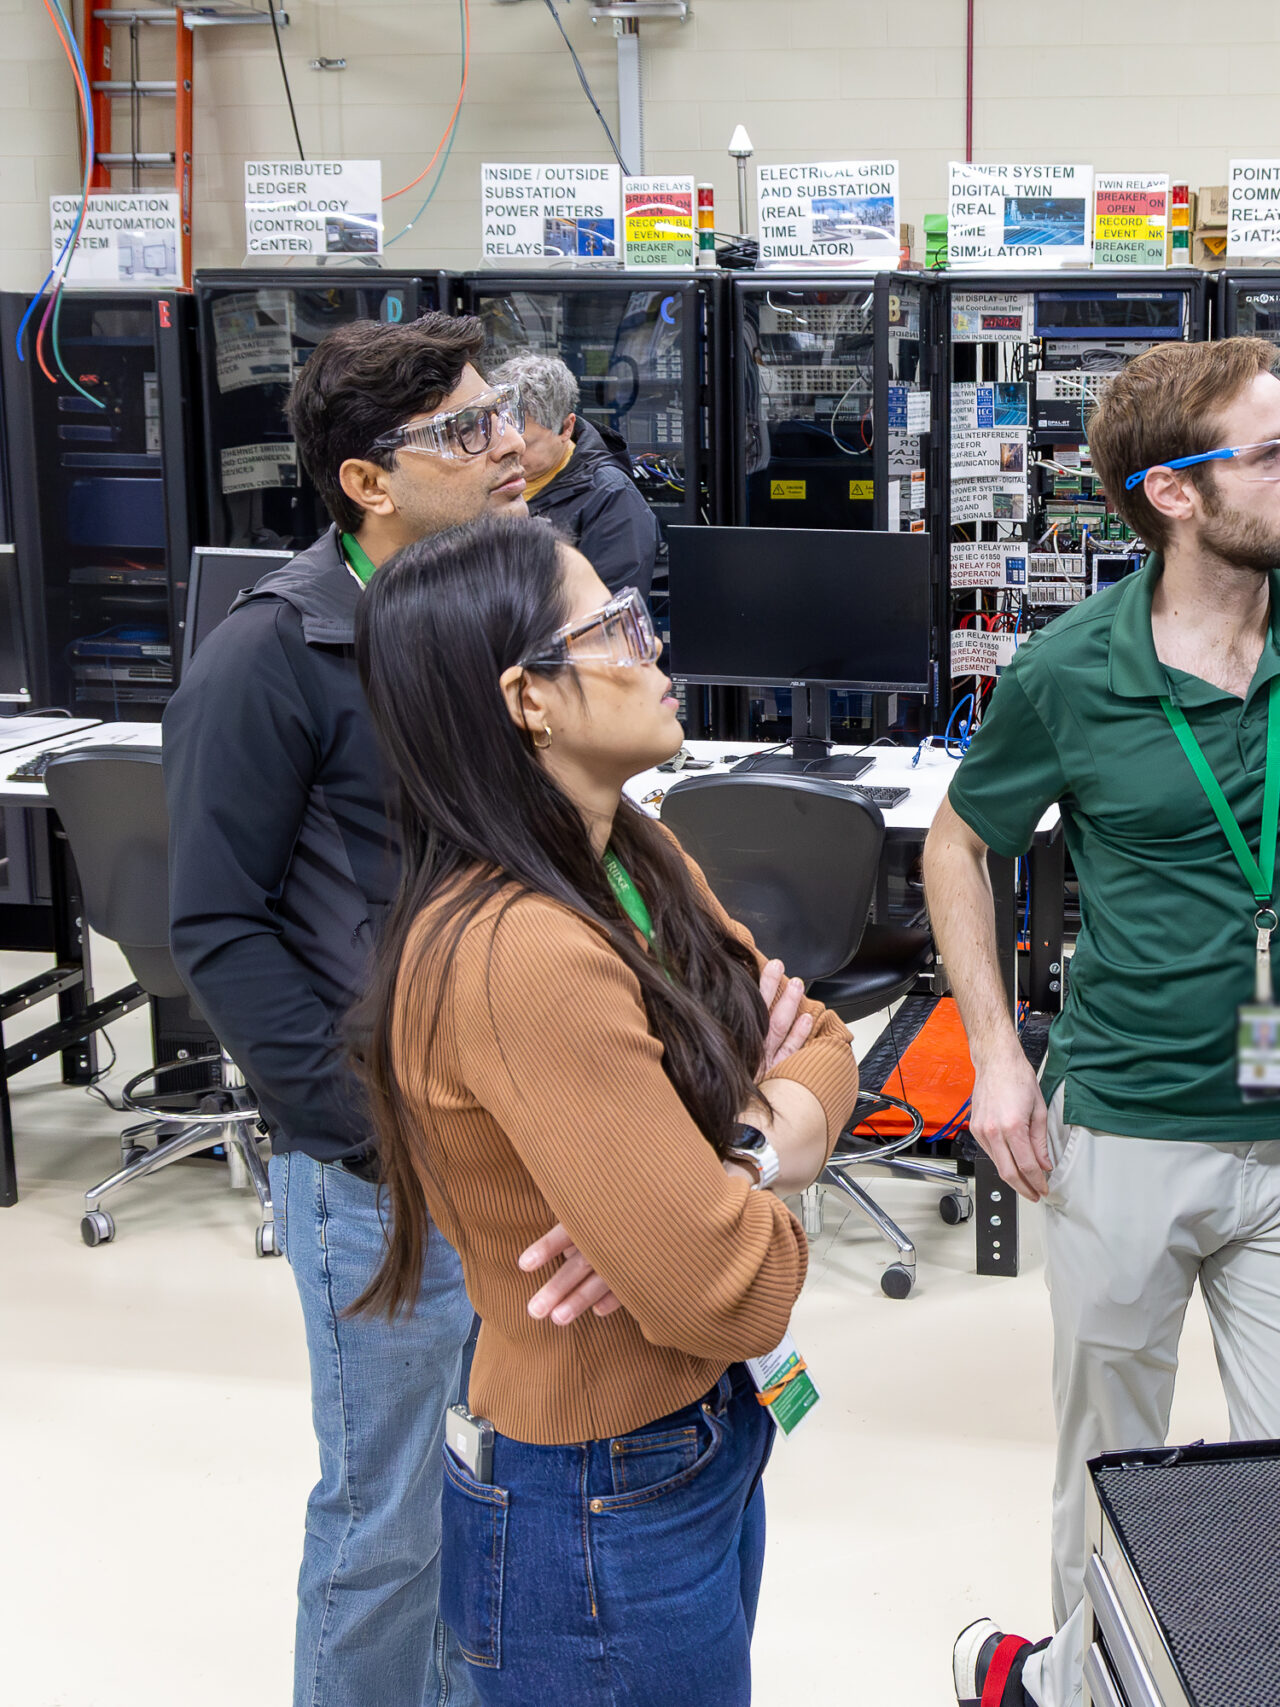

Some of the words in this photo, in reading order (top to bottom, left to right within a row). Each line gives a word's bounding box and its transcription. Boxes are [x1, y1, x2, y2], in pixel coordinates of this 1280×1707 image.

[248, 164, 343, 176] DISTRIBUTED
[486, 169, 531, 180] INSIDE
[537, 169, 540, 180] /
[545, 169, 609, 180] OUTSIDE
[858, 164, 895, 176] GRID
[1013, 167, 1074, 178] SYSTEM
[248, 183, 307, 194] LEDGER
[626, 183, 650, 191] GRID
[653, 183, 691, 191] RELAYS
[761, 187, 792, 199] AND
[797, 183, 890, 197] SUBSTATION
[952, 185, 1009, 196] DIGITAL
[1015, 185, 1052, 196] TWIN
[486, 187, 576, 199] SUBSTATION
[1097, 193, 1146, 201] BREAKER
[626, 195, 673, 203] BREAKER
[676, 200, 689, 208] ON
[486, 205, 539, 216] POWER
[544, 205, 603, 216] METERS
[762, 206, 806, 221] (REAL
[952, 203, 996, 217] (REAL
[1107, 205, 1135, 213] OPEN
[53, 220, 79, 230] AN
[86, 218, 175, 229] AUTOMATION
[250, 220, 323, 234] (CONTROL
[485, 224, 516, 235] AND
[634, 231, 665, 239] EVENT
[762, 226, 796, 238] TIME
[1149, 230, 1162, 238] NK
[250, 239, 312, 253] CENTER)
[486, 243, 542, 255] RELAYS
[626, 243, 674, 252] BREAKER
[763, 243, 854, 257] SIMULATOR)
[1096, 242, 1144, 250] BREAKER
[677, 249, 691, 257] ON
[1102, 254, 1137, 262] CLOSE
[1147, 249, 1162, 257] ON
[634, 255, 667, 263] CLOSE
[158, 300, 172, 328] E
[387, 296, 403, 322] D
[661, 296, 675, 324] C
[889, 295, 900, 322] B
[967, 632, 990, 640] RELAY
[983, 649, 997, 657] FOR
